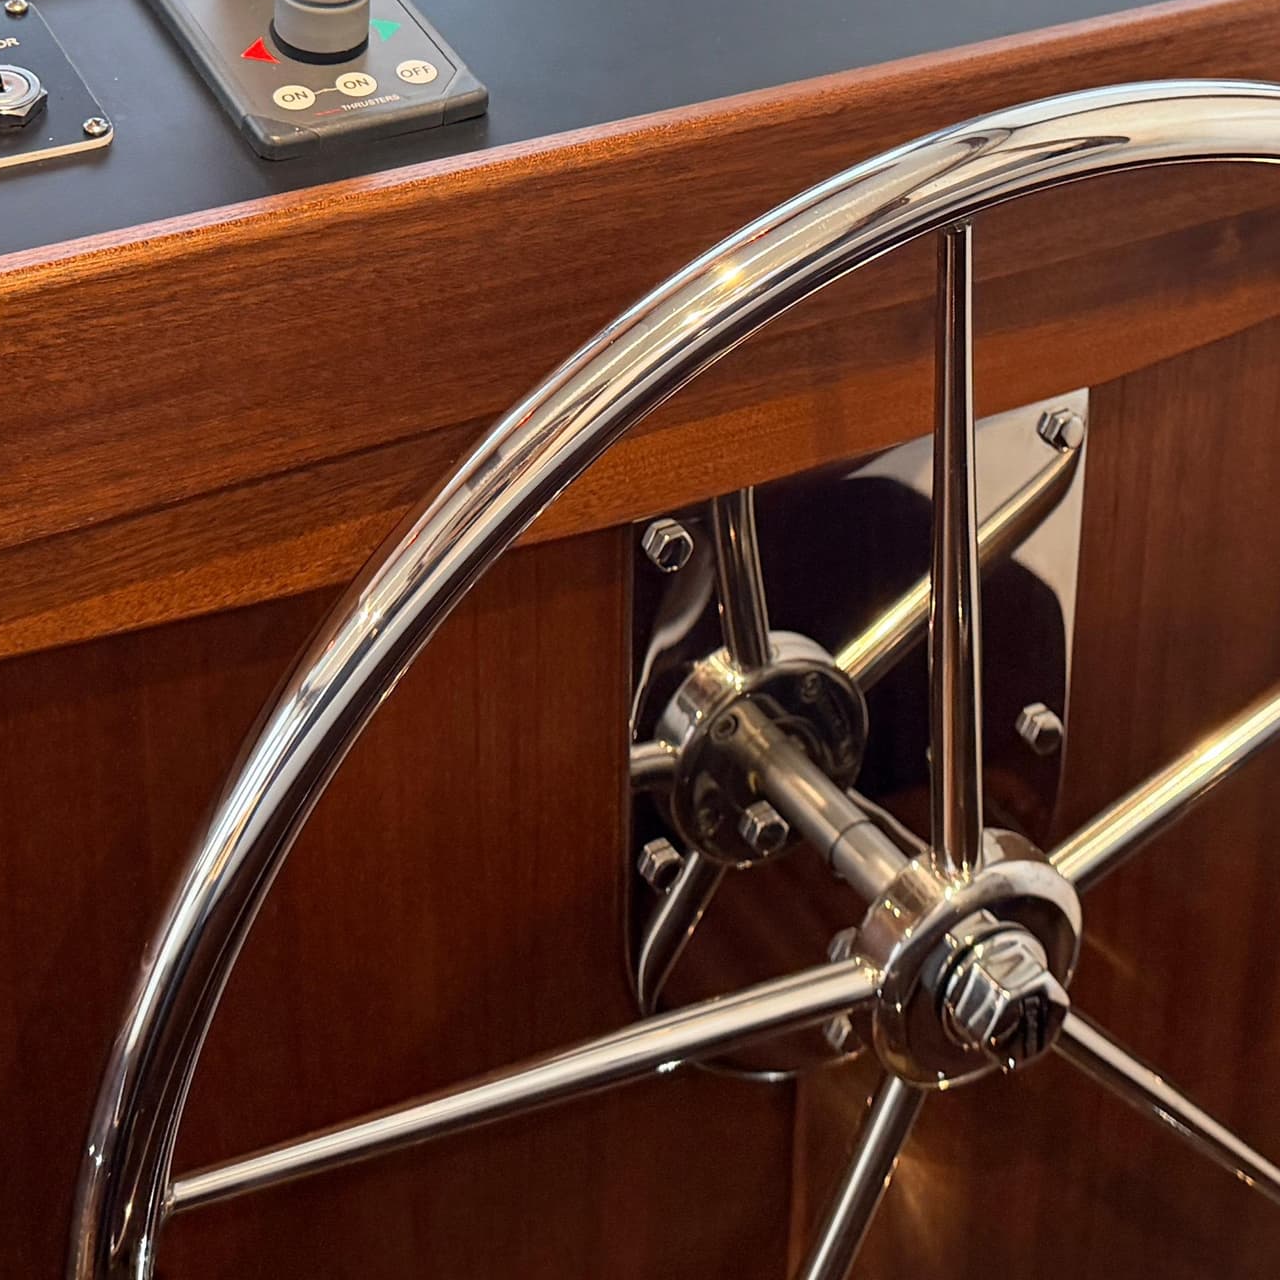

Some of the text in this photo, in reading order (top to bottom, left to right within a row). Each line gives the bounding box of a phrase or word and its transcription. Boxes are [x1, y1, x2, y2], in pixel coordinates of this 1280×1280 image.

[400, 65, 433, 78] OFF
[342, 77, 370, 90] ON
[281, 90, 309, 103] ON
[341, 94, 401, 112] THRUSTERS
